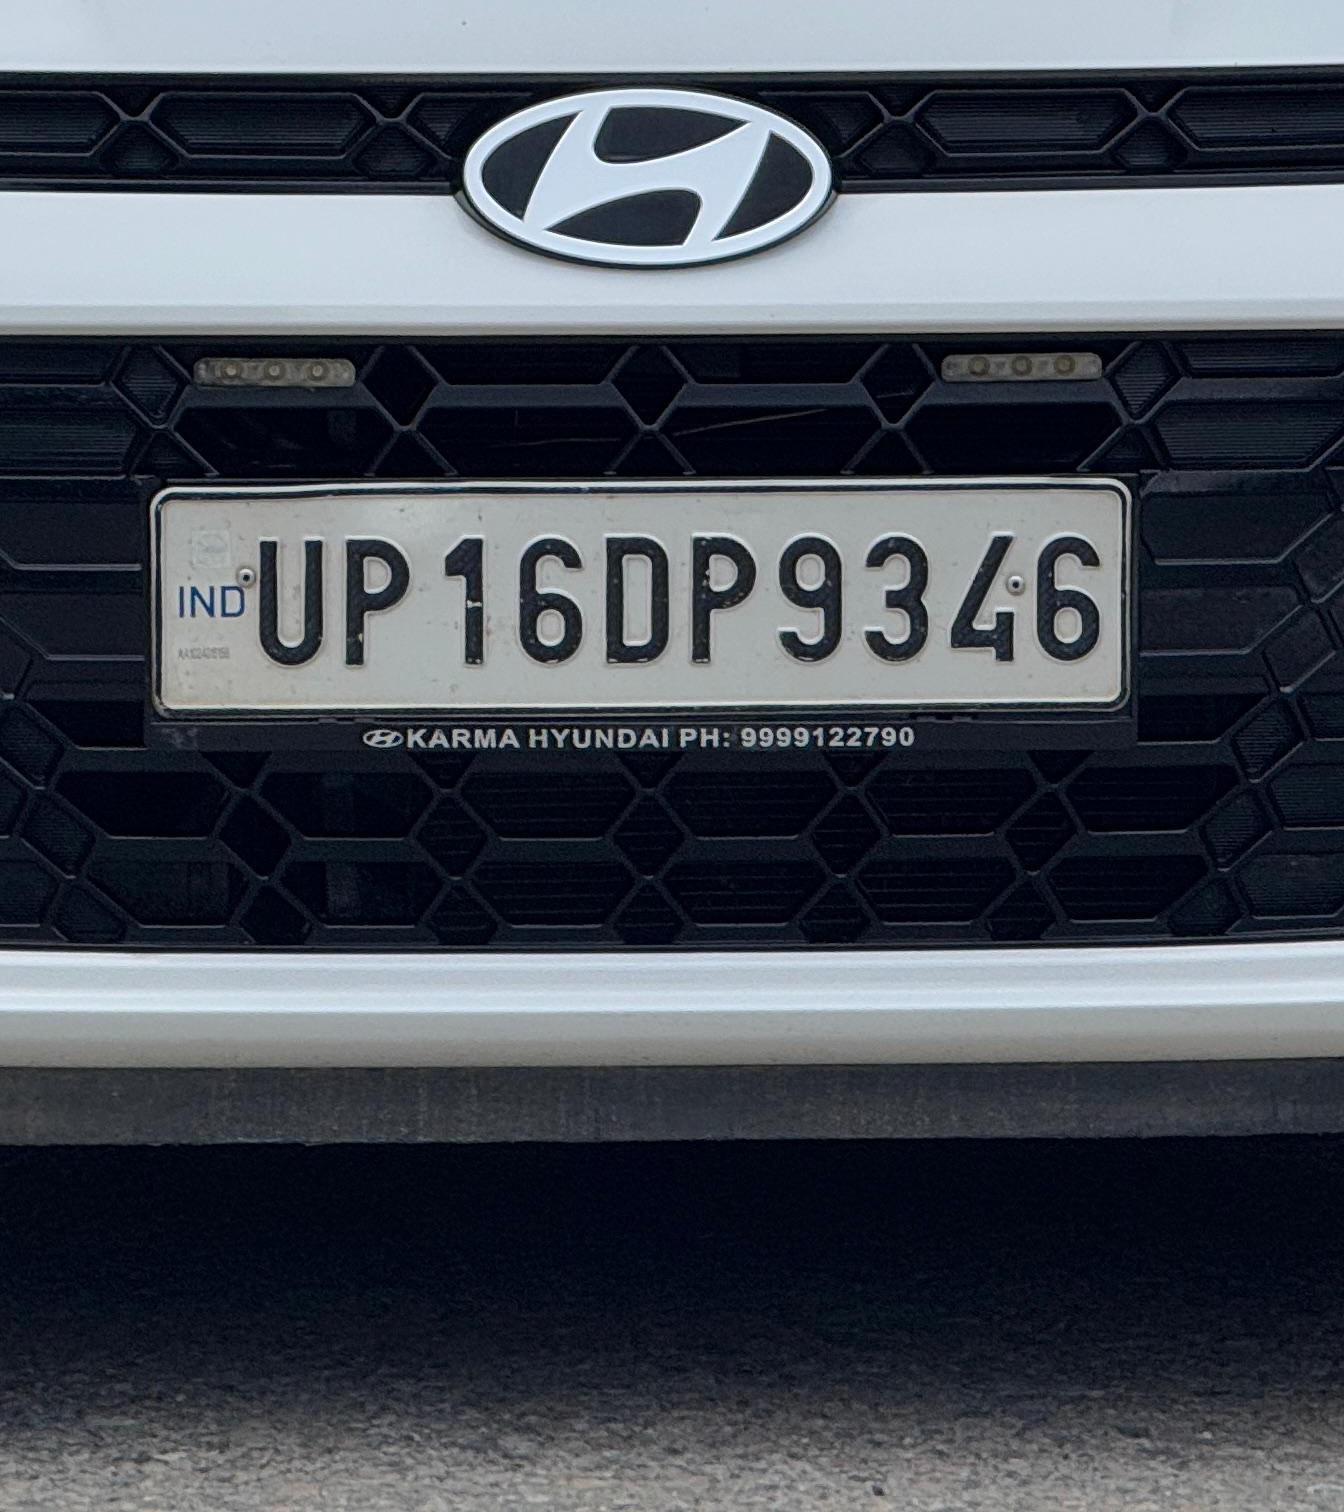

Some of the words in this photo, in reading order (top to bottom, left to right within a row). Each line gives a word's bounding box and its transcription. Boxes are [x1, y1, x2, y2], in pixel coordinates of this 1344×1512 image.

[179, 586, 245, 618] IND
[256, 534, 1102, 667] UP16DP9346
[407, 728, 520, 749] KARMA
[529, 728, 669, 749] HYUNDAI
[680, 728, 730, 748] PH:
[741, 727, 914, 748] 9999122790
